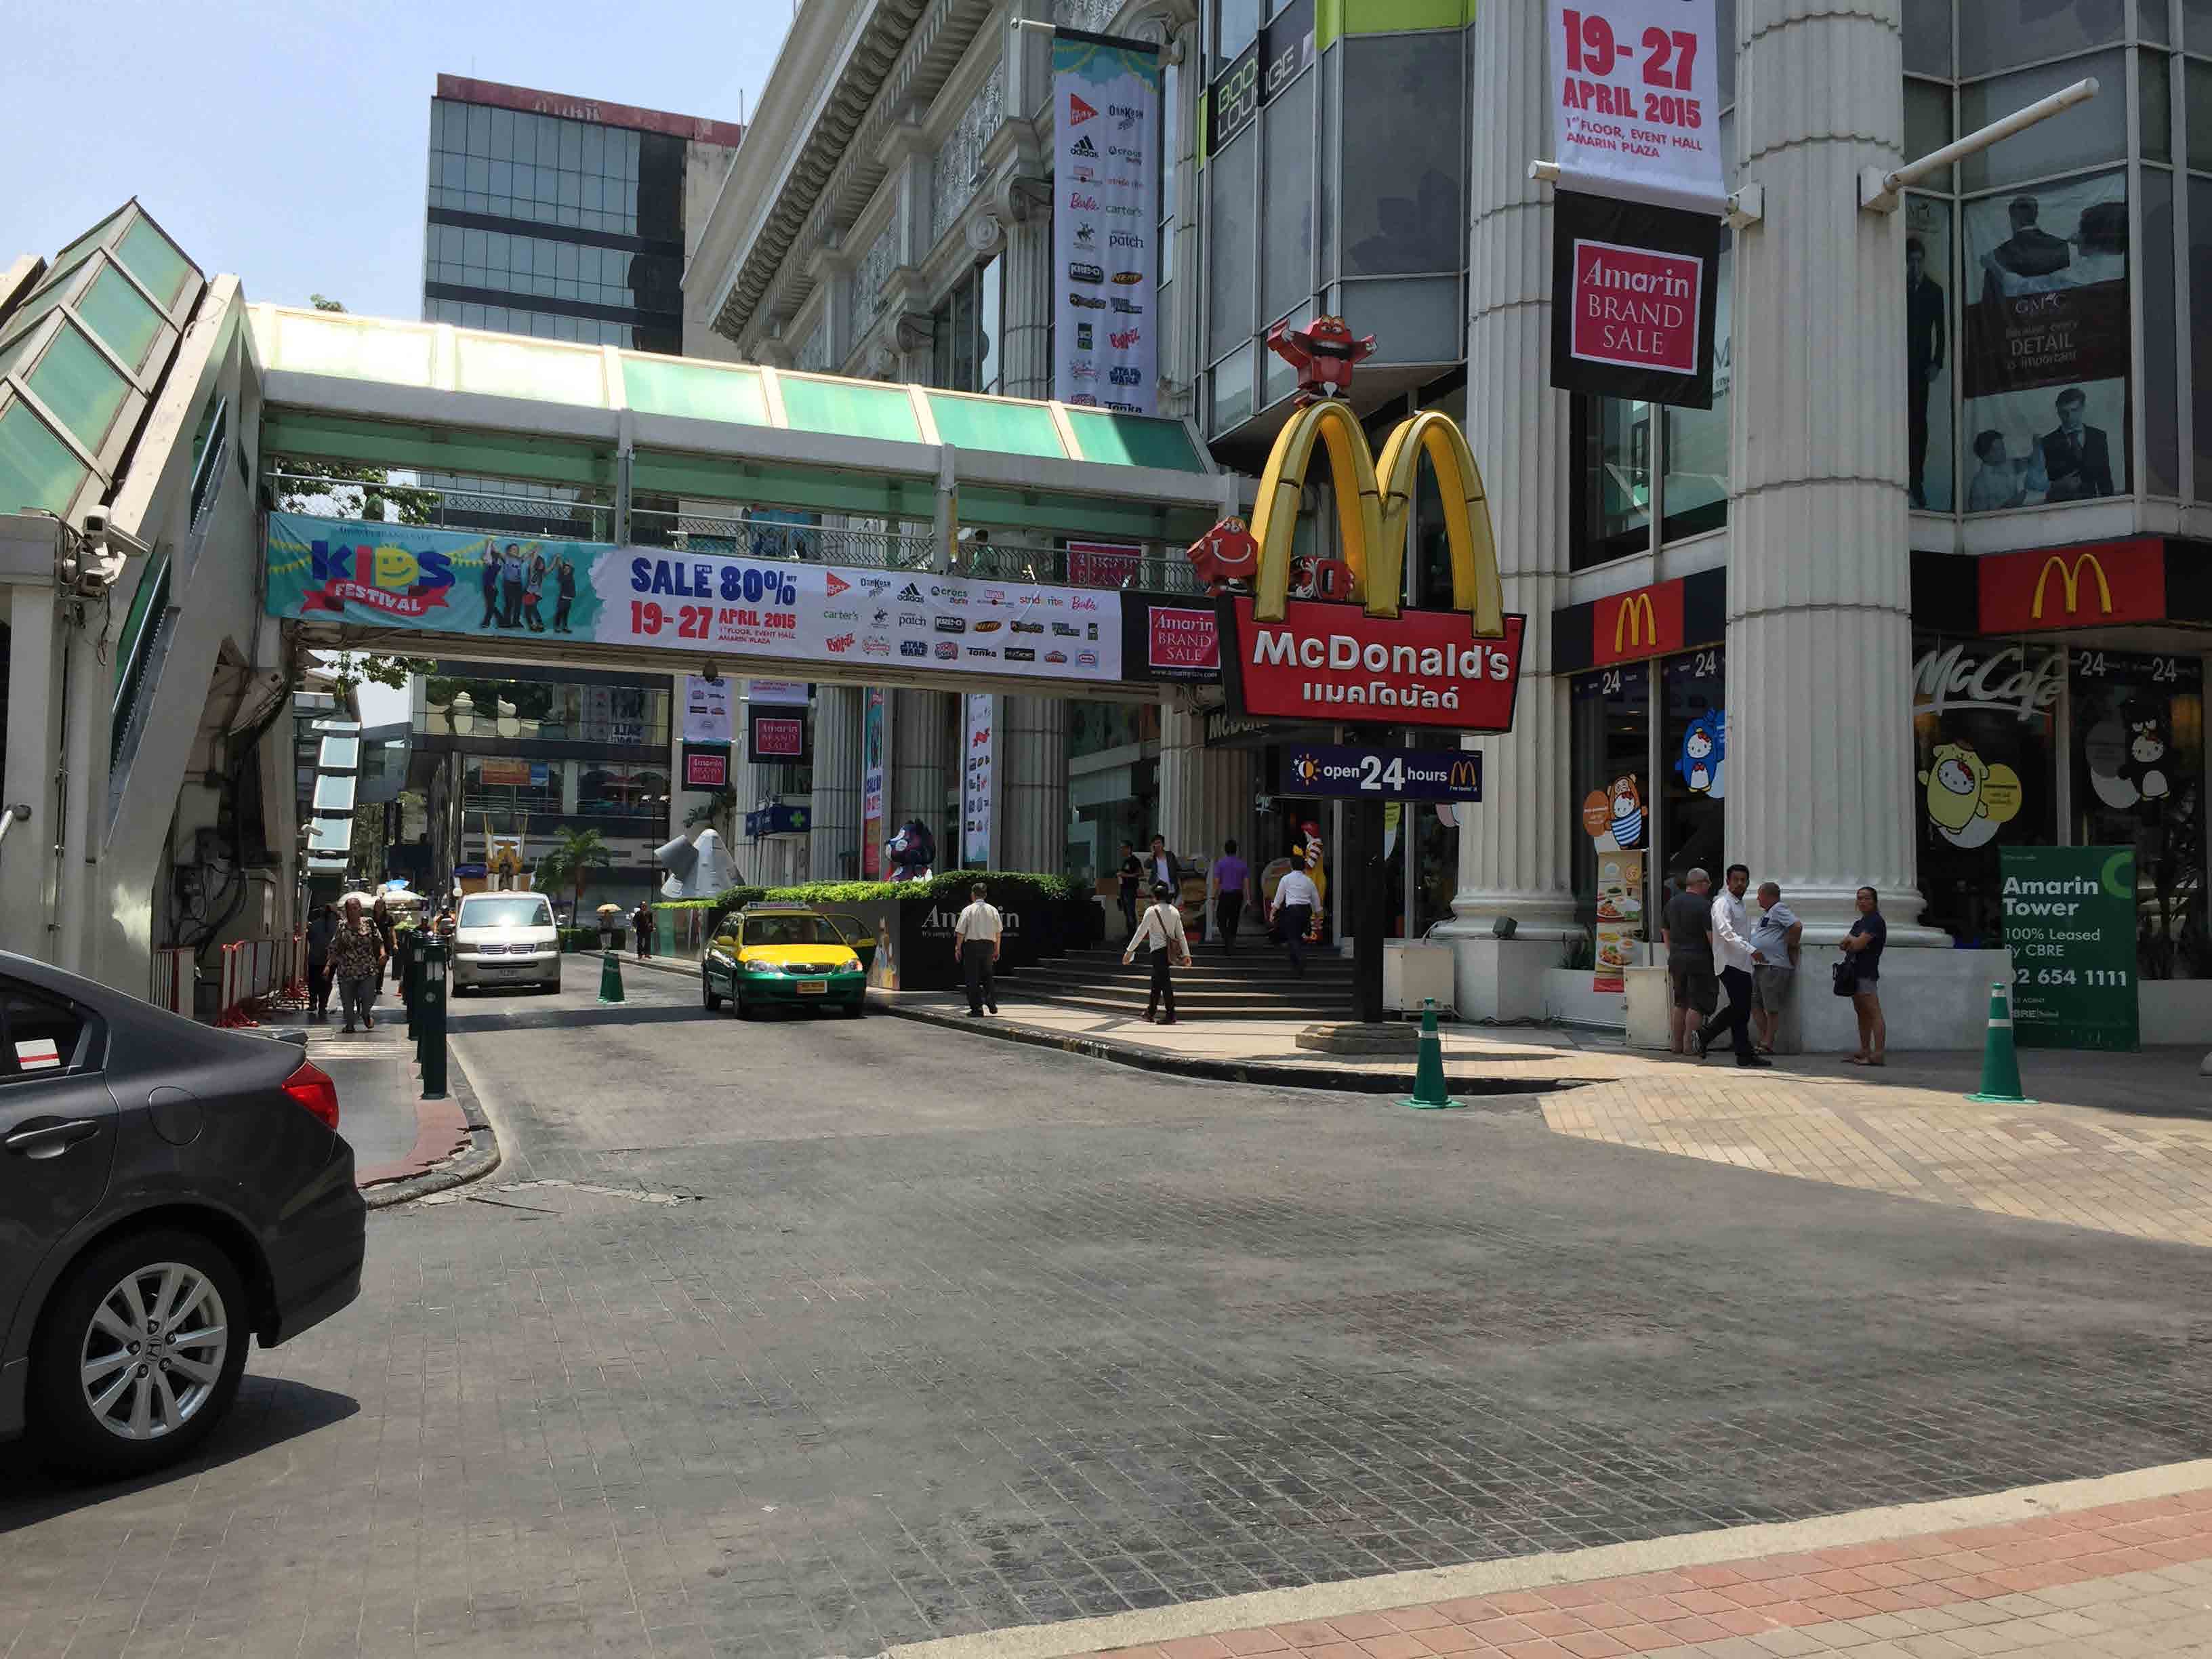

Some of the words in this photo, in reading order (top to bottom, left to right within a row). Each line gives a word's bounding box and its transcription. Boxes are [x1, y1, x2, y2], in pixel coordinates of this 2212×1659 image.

[1218, 57, 1258, 115] BOO
[1562, 77, 1638, 119] APRIL
[1643, 92, 1702, 129] 2015
[1566, 132, 1616, 151] AMARIN
[1621, 143, 1660, 158] PLAZA
[1580, 118, 1625, 140] FLOOR,
[1631, 129, 1667, 145] EVENT
[1672, 136, 1703, 152] HALL
[1582, 256, 1689, 299] Amarin
[1587, 293, 1683, 328] BRAND
[1603, 325, 1664, 356] SALE
[2011, 331, 2075, 357] DETAIL
[310, 539, 456, 588] KIDS
[631, 556, 713, 598] SALE
[720, 565, 797, 606] 80%
[334, 582, 422, 612] FESTIVAL
[897, 594, 924, 603] adidas
[718, 607, 760, 628] APRIL
[764, 612, 797, 630] 2015
[1155, 613, 1214, 632] Amarin
[1159, 632, 1212, 647] BRAND
[1166, 647, 1203, 661] SALE
[1252, 630, 1511, 682] McDonald's
[1695, 650, 1717, 677] 24
[2080, 651, 2107, 677] 24
[1602, 669, 1621, 695] 24
[2152, 656, 2177, 682] 24
[1303, 681, 1460, 711] แมคโดนัลด์
[1323, 764, 1360, 781] open
[1359, 756, 1406, 792] 24
[1407, 766, 1448, 782] hours
[2002, 876, 2099, 895] Amarin
[922, 905, 1020, 928] Amin
[2002, 897, 2080, 916] Tower
[2005, 927, 2045, 939] 100%
[2049, 927, 2101, 941] Leased
[2026, 944, 2066, 957] CBRE
[2012, 968, 2030, 985] 2
[2037, 968, 2077, 985] 654
[2085, 969, 2127, 987] 1111
